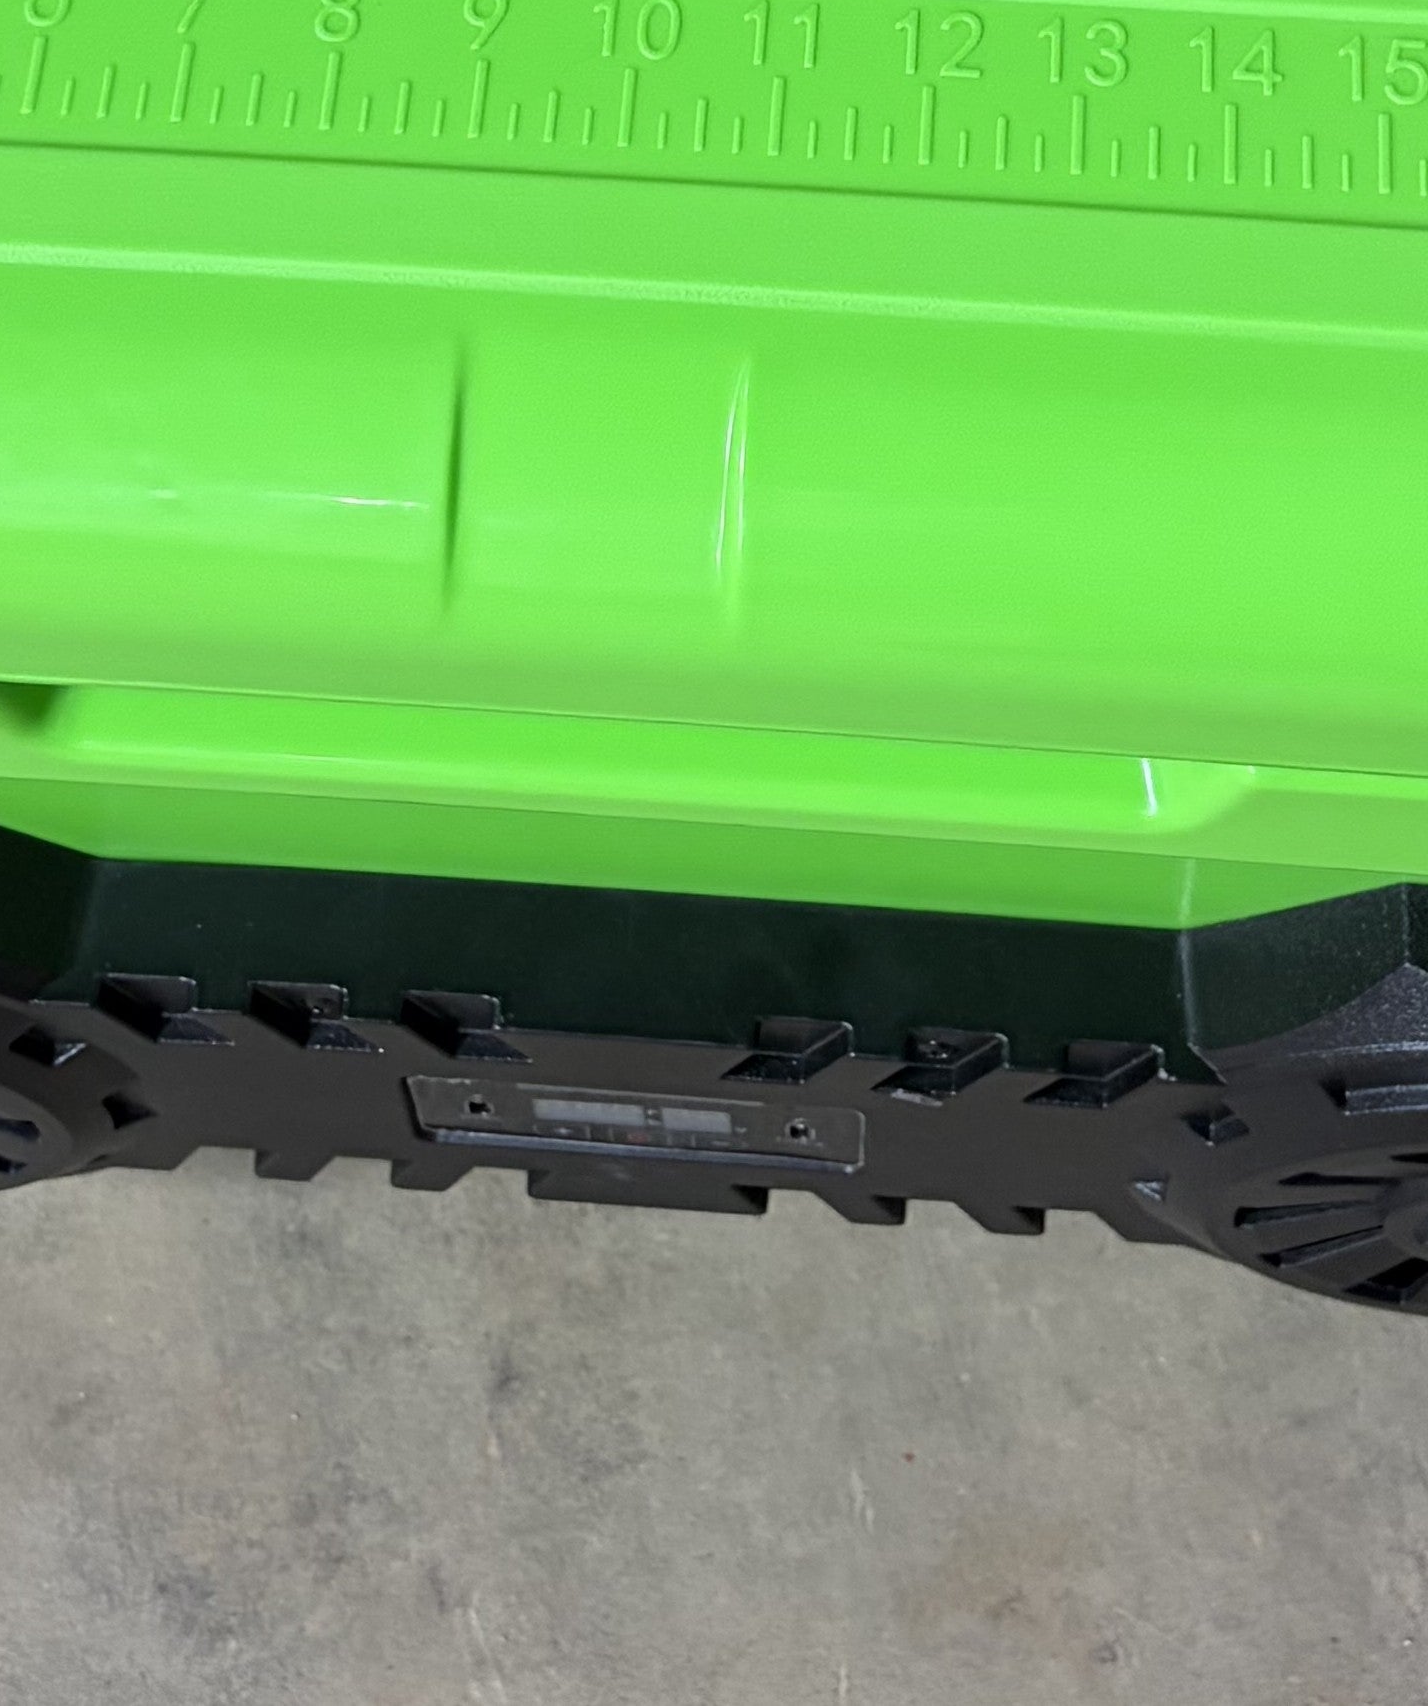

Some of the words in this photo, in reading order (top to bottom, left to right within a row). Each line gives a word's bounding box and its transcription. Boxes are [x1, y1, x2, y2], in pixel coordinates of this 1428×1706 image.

[742, 0, 823, 71] 11
[893, 7, 986, 80] 12
[1037, 15, 1130, 89] 13
[1188, 25, 1285, 97] 14
